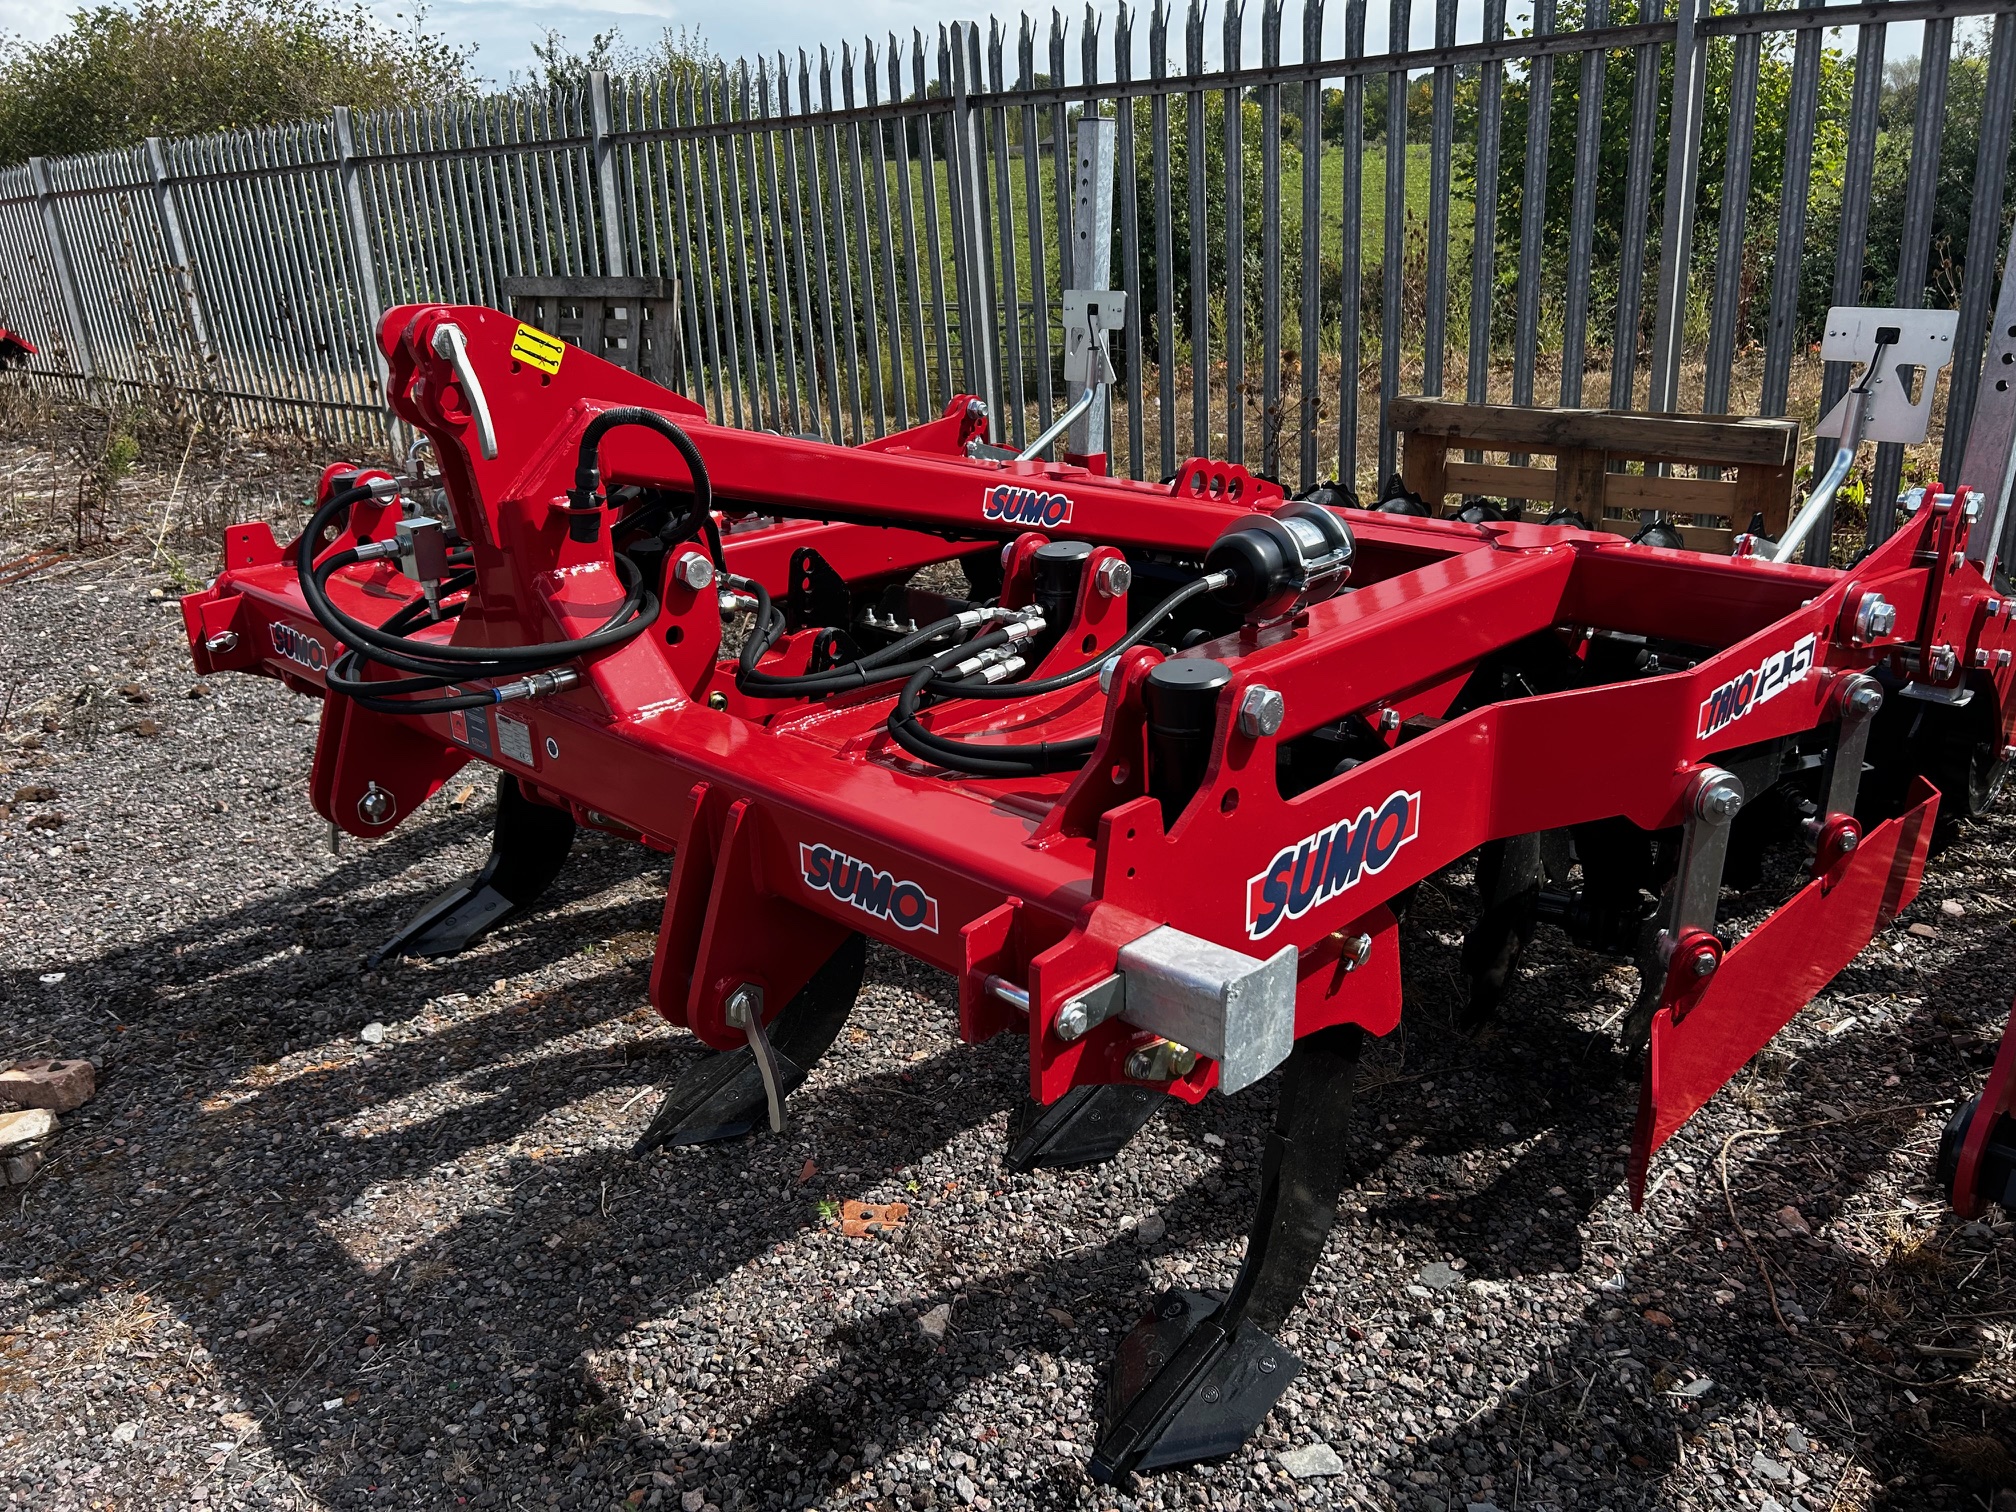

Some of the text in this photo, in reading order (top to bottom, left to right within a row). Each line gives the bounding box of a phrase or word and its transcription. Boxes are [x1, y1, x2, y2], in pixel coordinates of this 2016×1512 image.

[985, 485, 1069, 527] SUMO
[274, 623, 323, 671] SUMO
[805, 844, 929, 929] SUMO
[1251, 792, 1411, 937] SUMO
